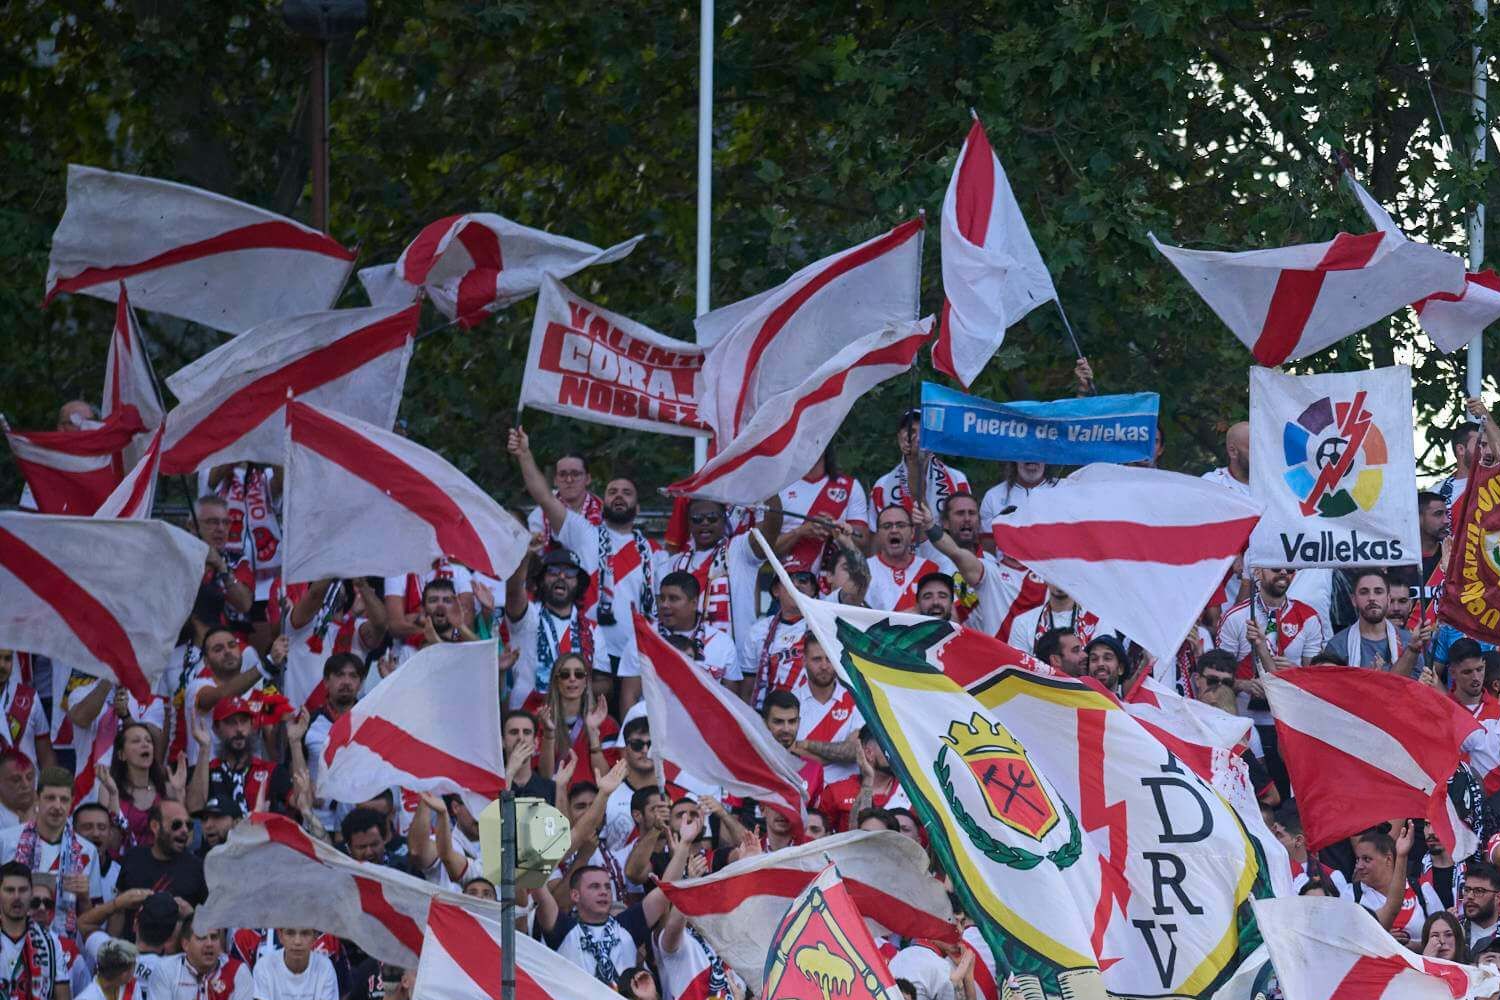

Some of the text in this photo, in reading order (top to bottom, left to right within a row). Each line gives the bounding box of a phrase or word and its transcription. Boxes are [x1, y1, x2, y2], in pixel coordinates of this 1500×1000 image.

[558, 332, 705, 403] CORAJ
[558, 376, 716, 432] NOBLEZ
[963, 412, 1149, 442] Puerto de Vallekas
[1280, 530, 1403, 563] Vallekas
[1132, 749, 1214, 989] DRV
